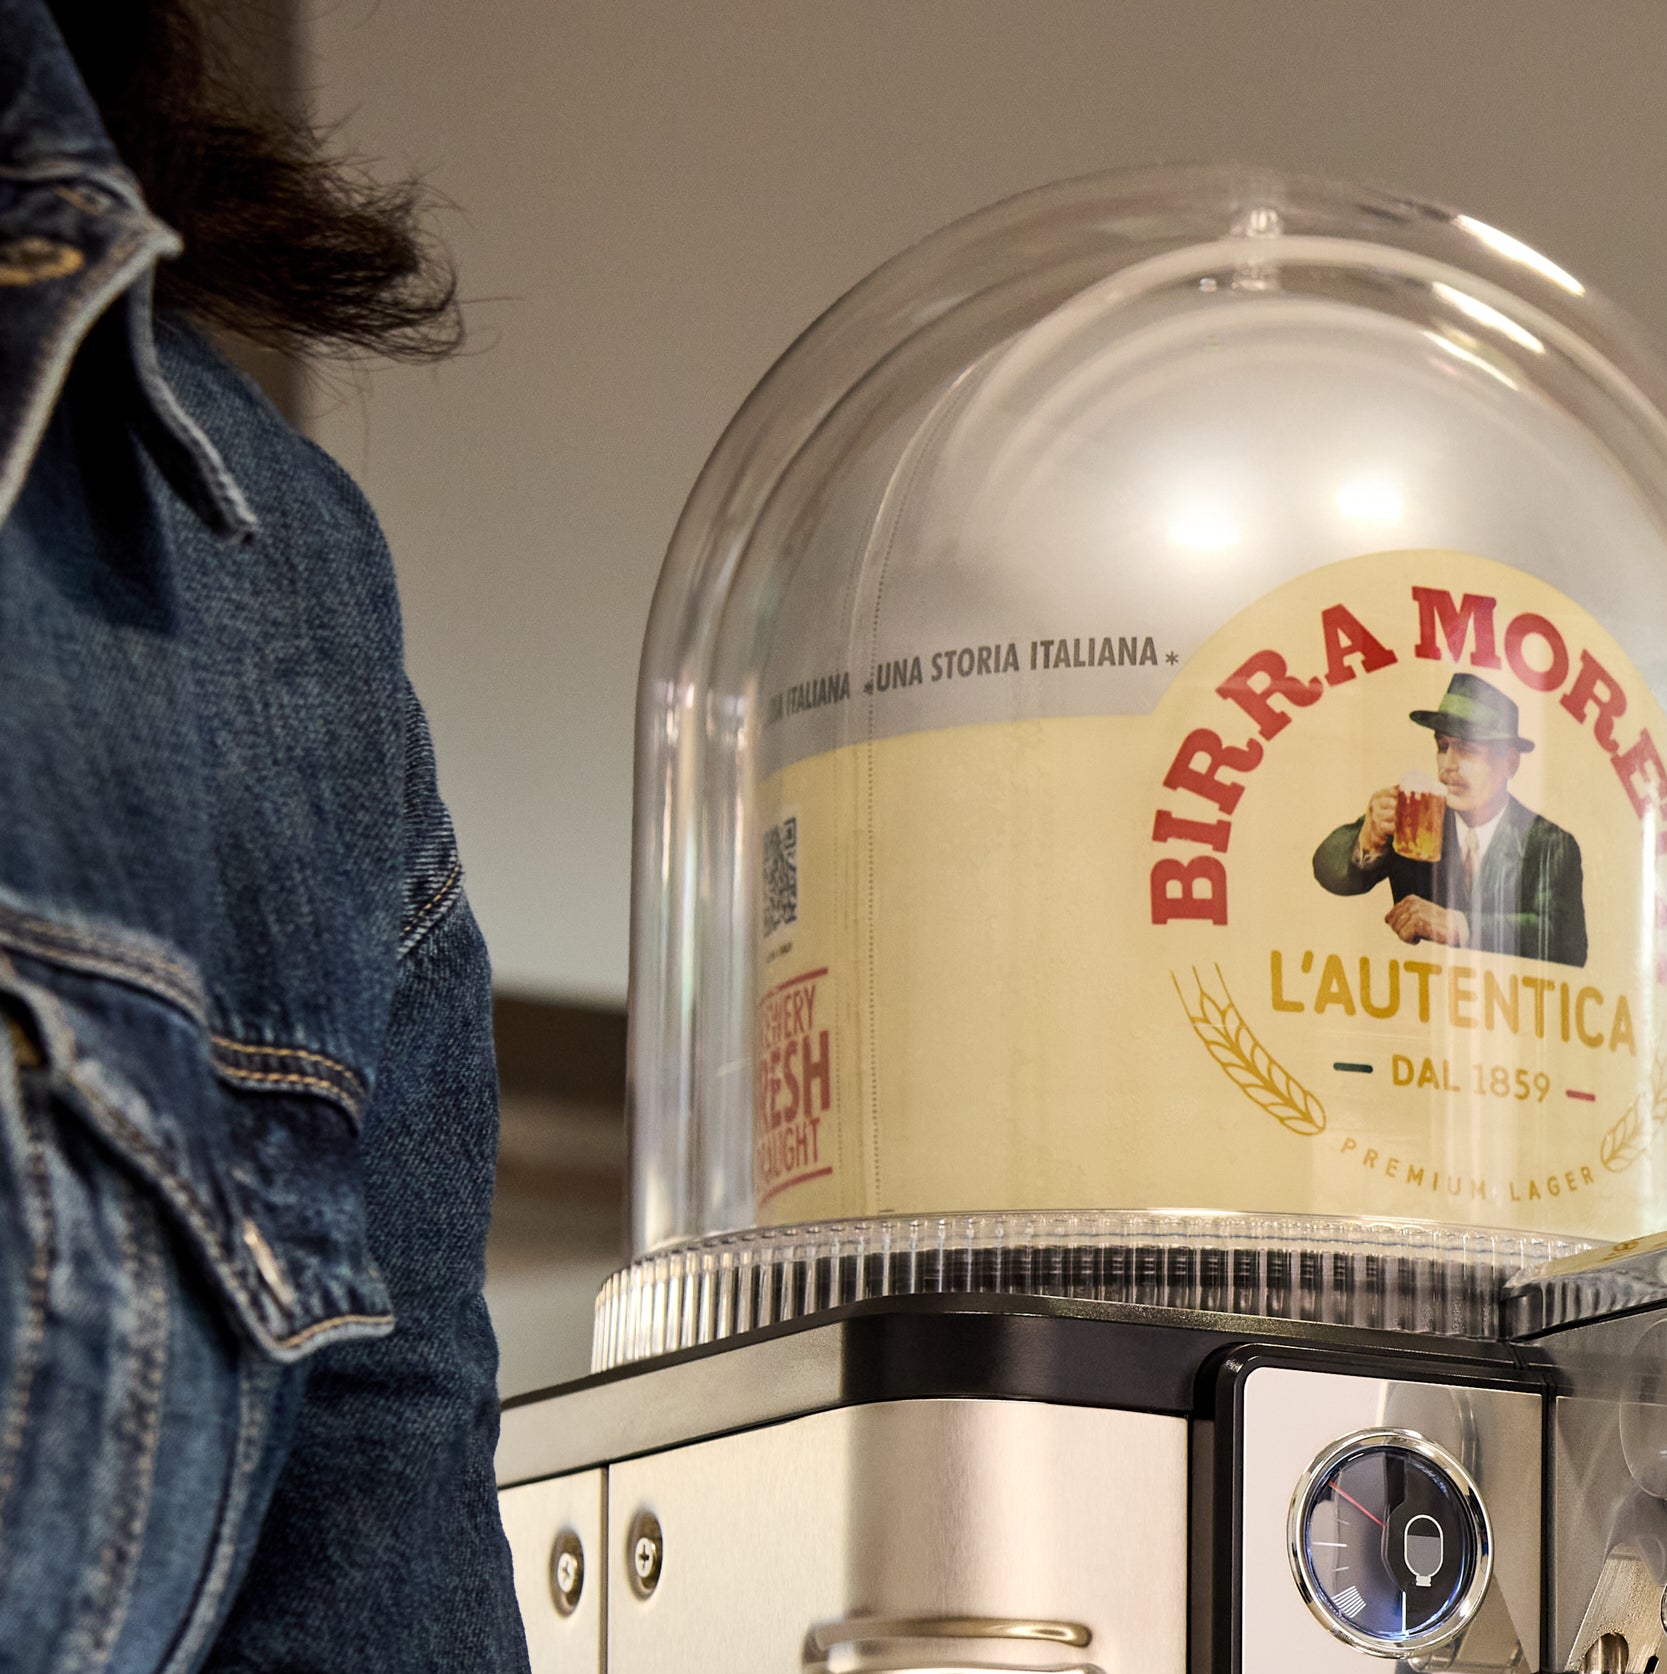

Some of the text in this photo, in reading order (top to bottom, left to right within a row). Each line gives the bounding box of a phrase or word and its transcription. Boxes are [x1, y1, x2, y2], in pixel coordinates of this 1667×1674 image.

[786, 671, 850, 717] ITALIANA
[876, 636, 1159, 692] UNA STORIA ITALIANA
[1150, 603, 1398, 926] BIRRA
[1270, 949, 1637, 1057] L'AUTENTICA
[760, 1030, 830, 1133] RESH
[1391, 1053, 1551, 1103] DAL 1859
[1340, 1137, 1595, 1202] PREMIUM LAGER
